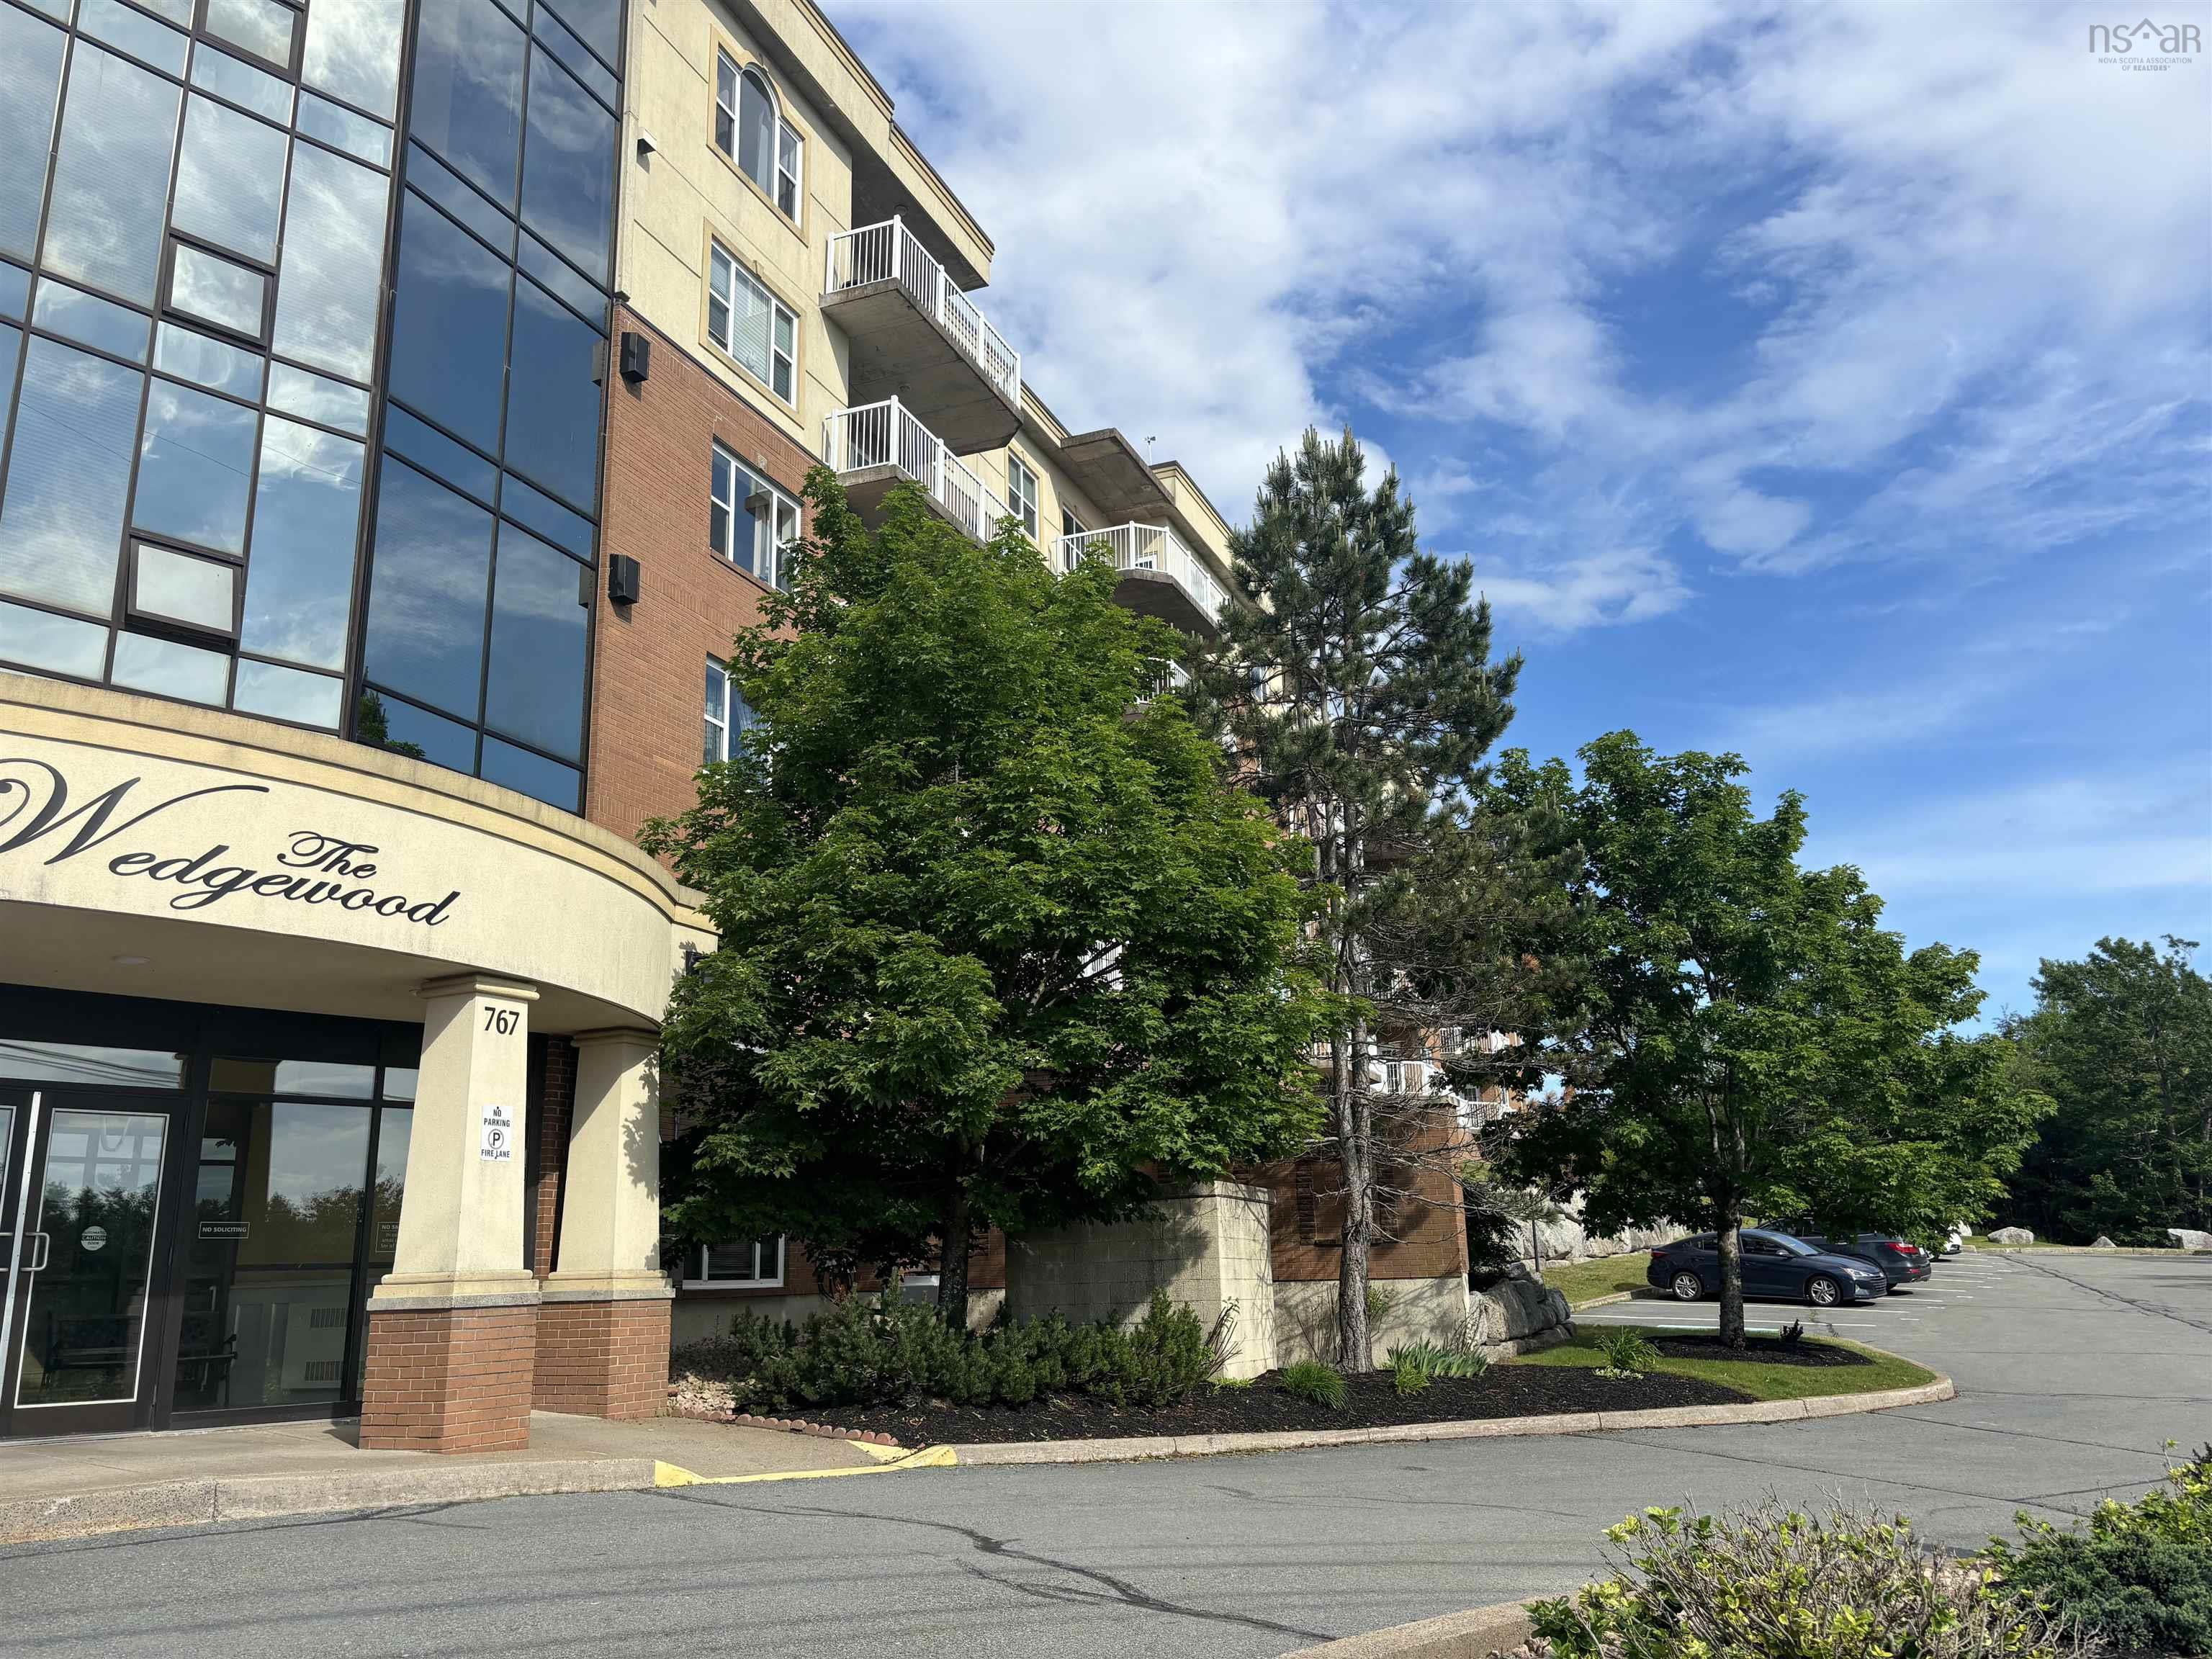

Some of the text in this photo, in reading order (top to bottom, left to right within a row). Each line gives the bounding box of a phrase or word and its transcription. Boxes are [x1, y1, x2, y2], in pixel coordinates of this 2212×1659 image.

[0, 757, 461, 926] Wedgewood
[277, 830, 379, 879] The
[484, 1006, 520, 1035] 767
[484, 1118, 511, 1128] PARKING
[493, 1132, 500, 1146] P
[495, 1150, 511, 1159] LANE
